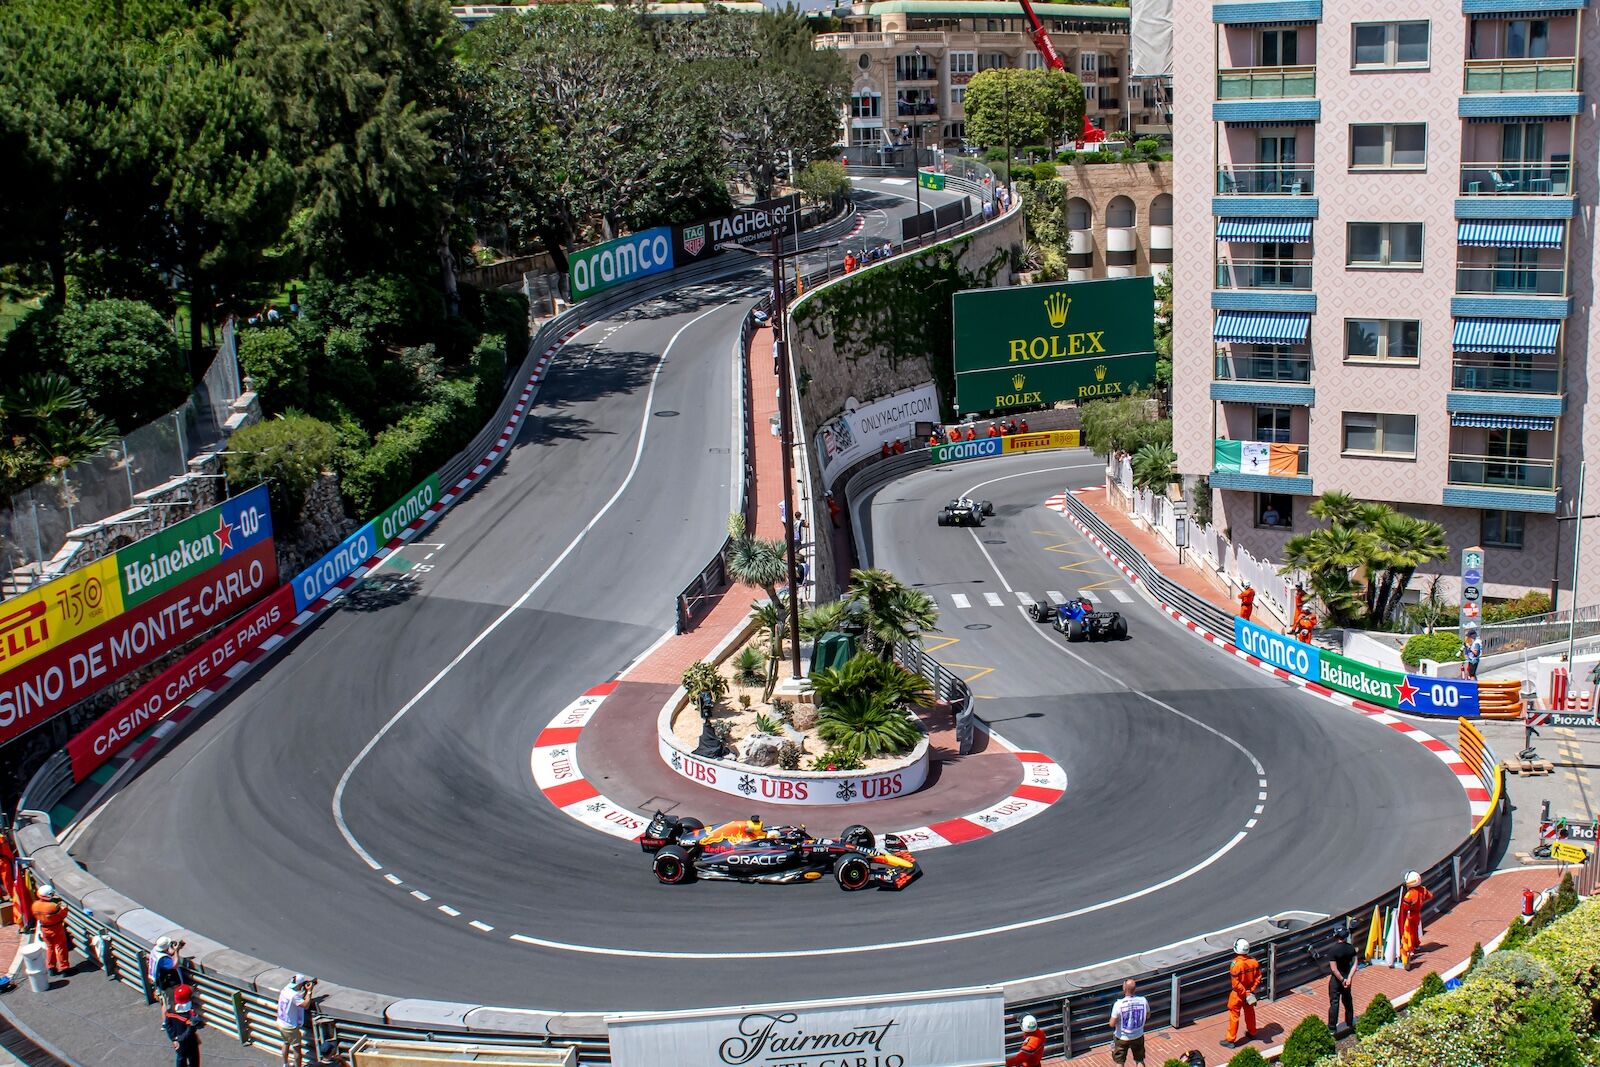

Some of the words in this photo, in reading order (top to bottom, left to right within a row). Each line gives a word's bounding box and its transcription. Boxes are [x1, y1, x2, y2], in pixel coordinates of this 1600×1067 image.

[684, 238, 705, 250] HEUER
[685, 228, 704, 239] TAG
[573, 233, 669, 292] aramco
[1008, 331, 1106, 362] ROLEX
[995, 391, 1042, 408] ROLEX
[1078, 382, 1122, 397] ROLEX
[861, 397, 933, 434] ONLYYACHT.COM
[938, 440, 996, 461] aramco
[1010, 434, 1051, 449] PIRELLI
[382, 485, 433, 539] aramco
[124, 534, 215, 595] Heineken
[303, 535, 368, 601] aramco
[56, 576, 102, 626] 150
[69, 642, 107, 689] DE
[110, 559, 264, 667] MONTE-CARLO
[1241, 626, 1309, 675] aramco
[93, 695, 162, 756] CASINO
[165, 657, 210, 701] CAFE
[211, 639, 236, 667] DE
[236, 605, 281, 648] PARIS
[1319, 658, 1393, 699] Heineken
[563, 707, 590, 725] UBS
[551, 758, 573, 780] UBS
[684, 760, 717, 785] UBS
[761, 778, 809, 800] UBS
[861, 773, 903, 800] UBS
[604, 810, 644, 830] UBS
[994, 800, 1028, 816] UBS
[899, 831, 930, 845] BS
[727, 855, 787, 865] ORACLE
[719, 1012, 900, 1065] Fairmont
